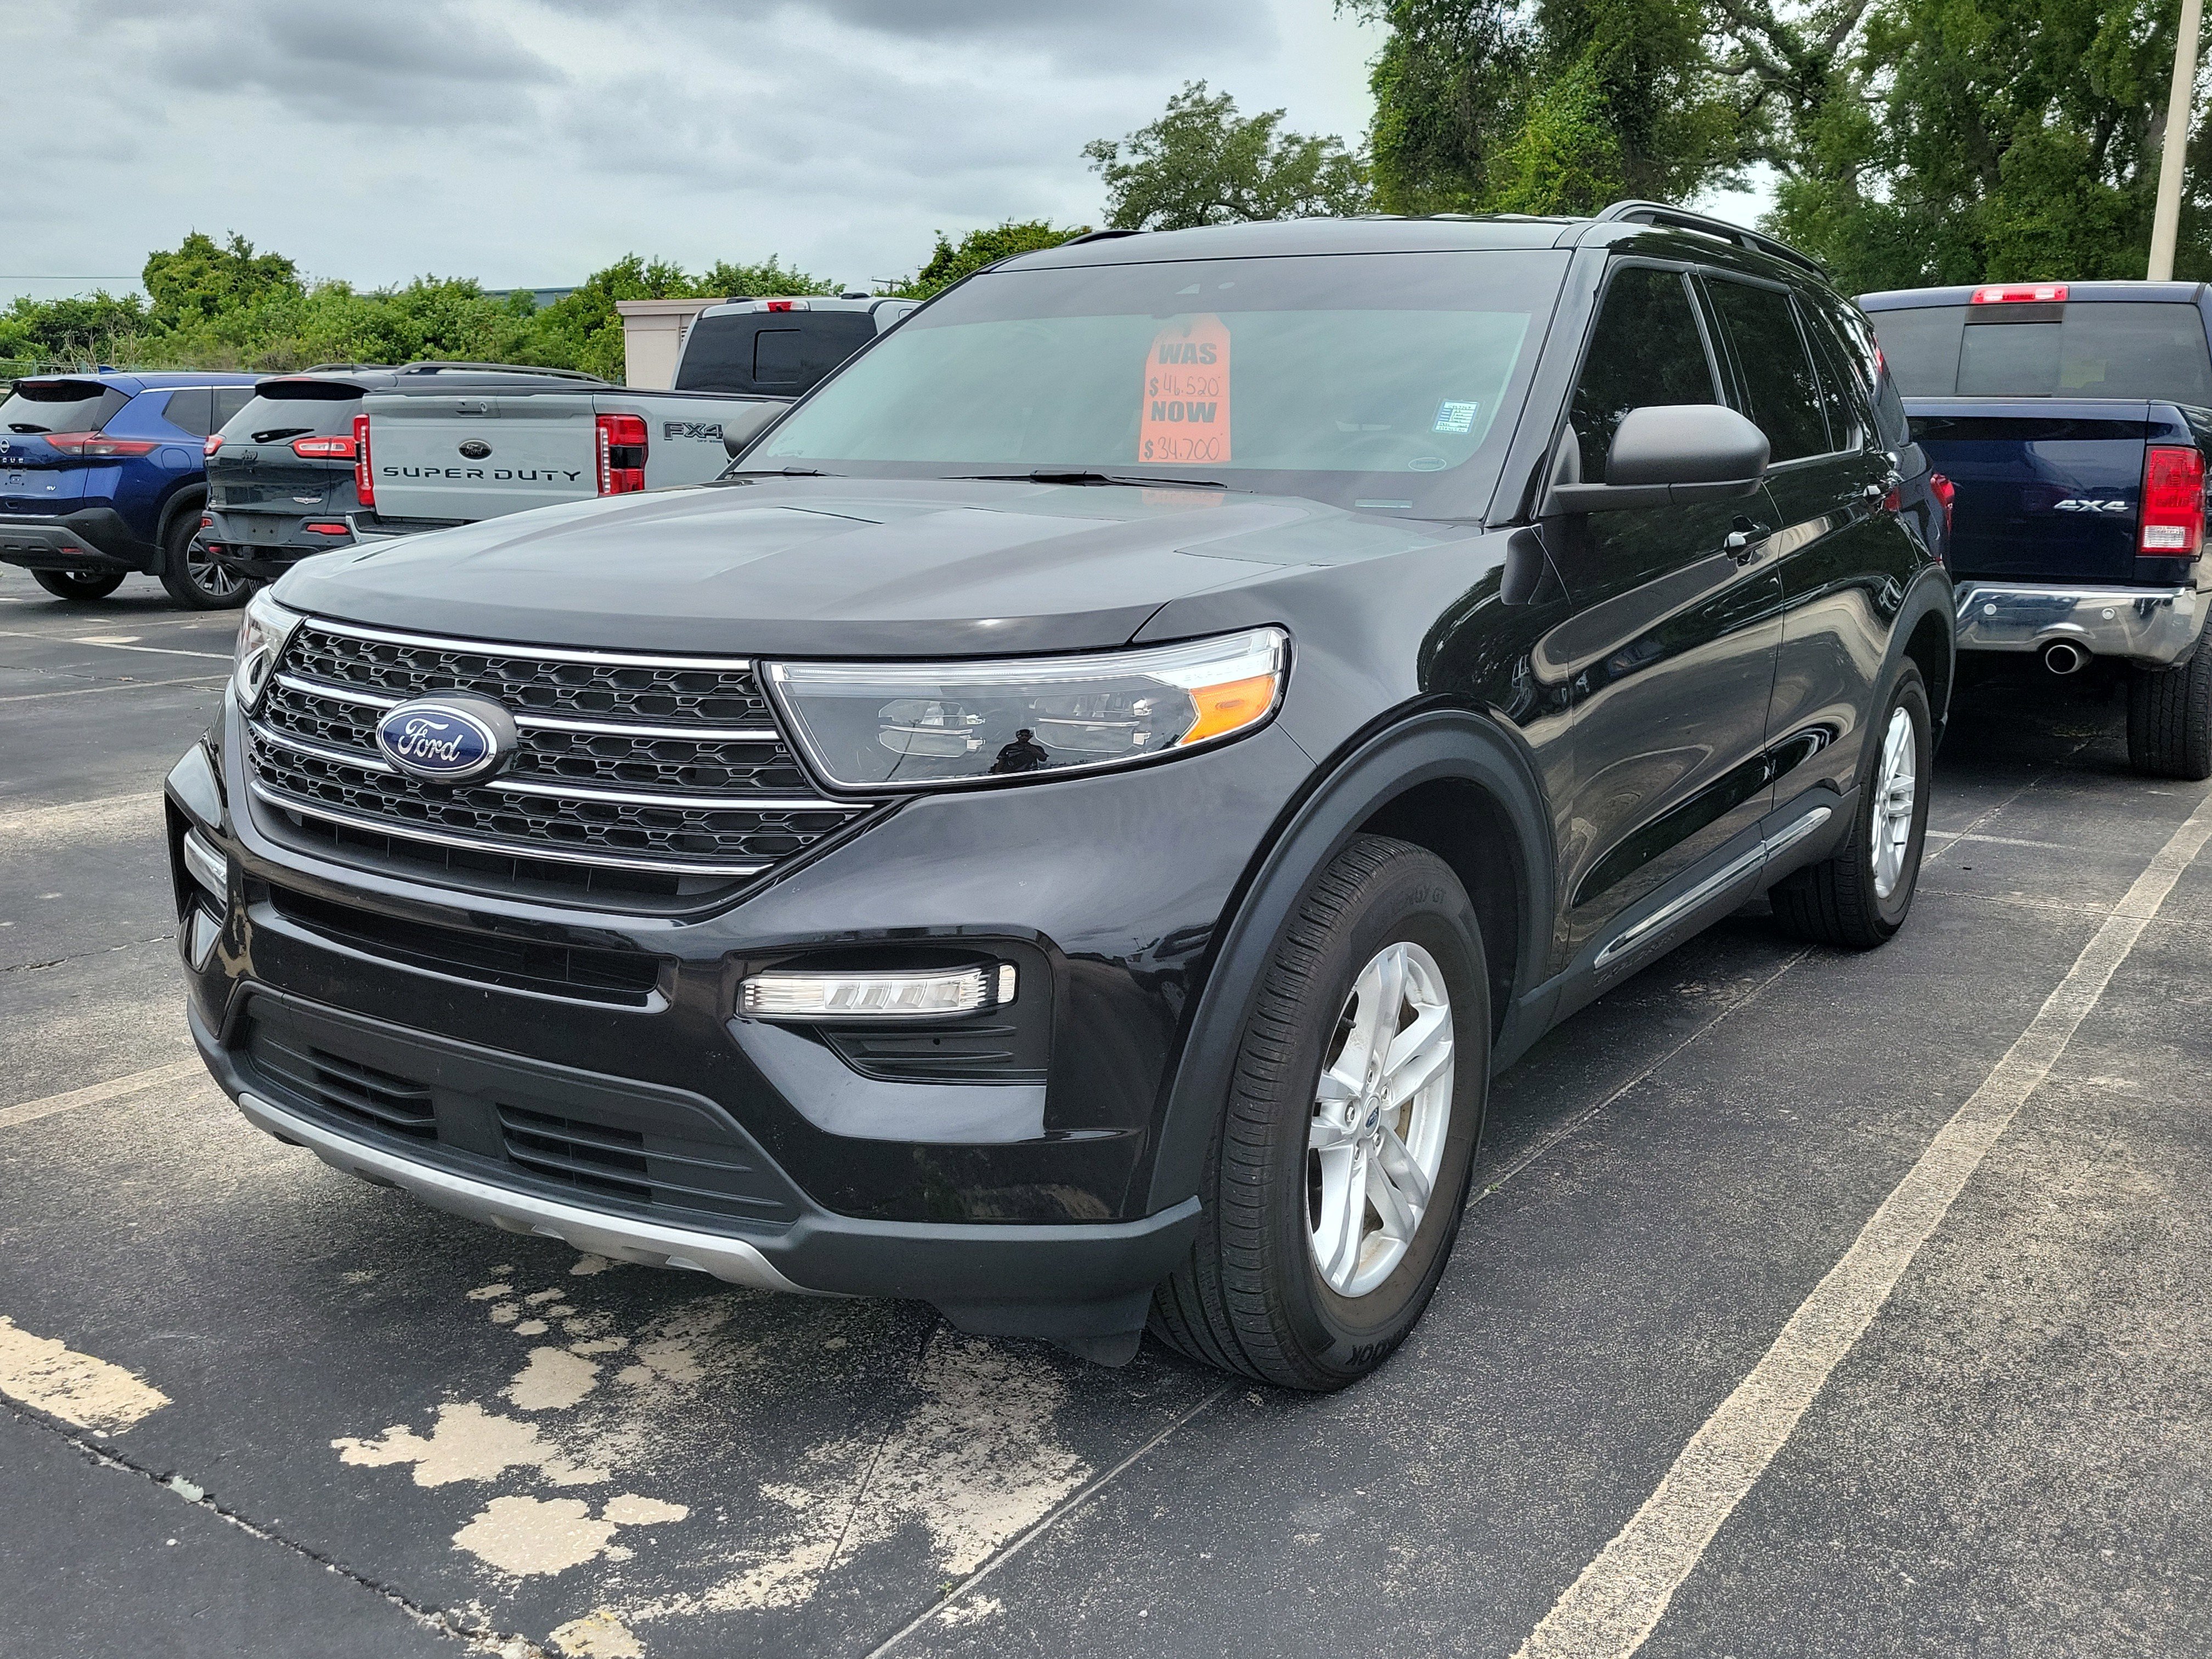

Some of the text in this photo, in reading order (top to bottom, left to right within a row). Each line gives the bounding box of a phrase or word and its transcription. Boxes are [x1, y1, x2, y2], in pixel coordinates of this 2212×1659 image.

[1159, 342, 1217, 365] WAS
[1151, 400, 1217, 423] NOW
[663, 421, 723, 441] FX4
[464, 443, 484, 456] Ford
[382, 466, 582, 482] SUPER DUTY
[398, 718, 464, 762] Ford
